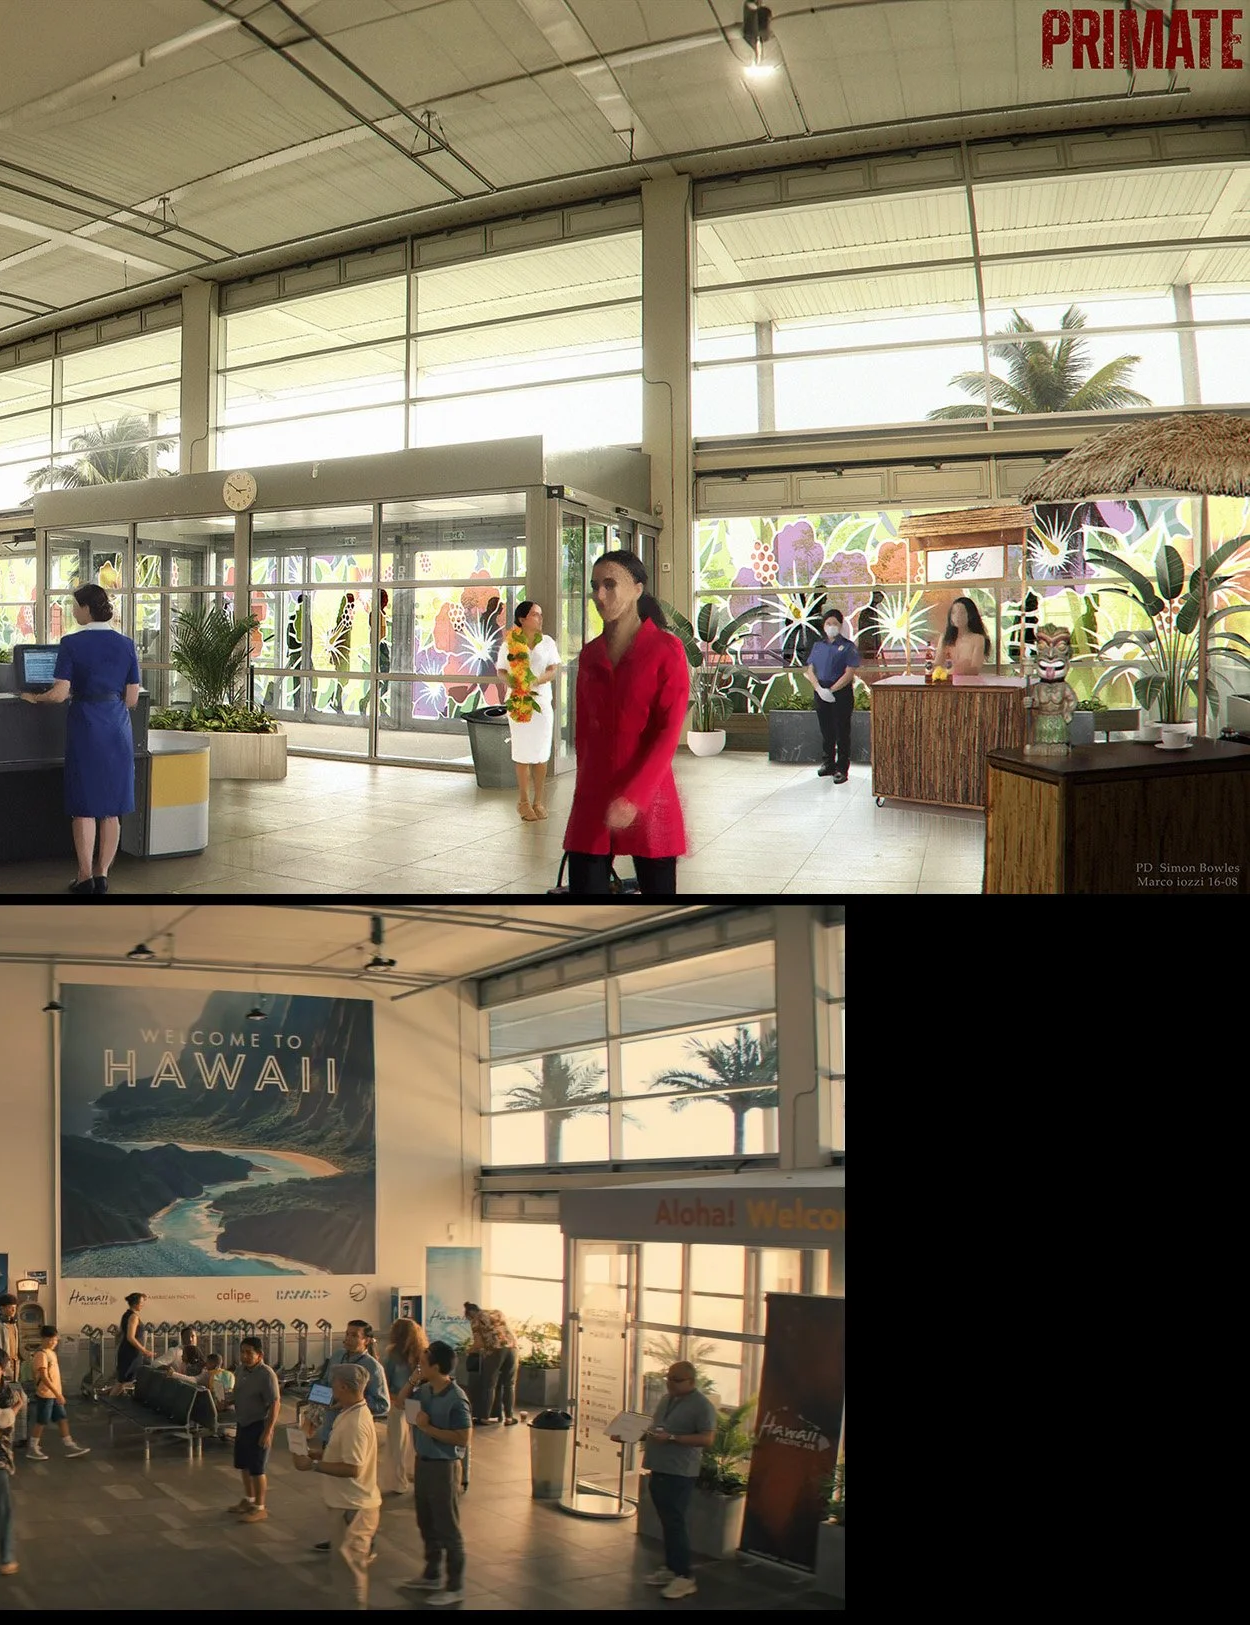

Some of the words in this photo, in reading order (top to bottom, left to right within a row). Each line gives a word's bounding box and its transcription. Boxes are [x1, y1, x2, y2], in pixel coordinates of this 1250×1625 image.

[140, 1028, 260, 1048] WELCOME
[274, 1034, 302, 1050] TO
[104, 1048, 337, 1094] HAWAII
[654, 1198, 736, 1228] Aloha!
[746, 1198, 845, 1231] Welco
[69, 1289, 109, 1306] Hawaii
[216, 1288, 252, 1303] calipe
[430, 1309, 468, 1324] Hawai
[759, 1411, 818, 1442] Hawaii
